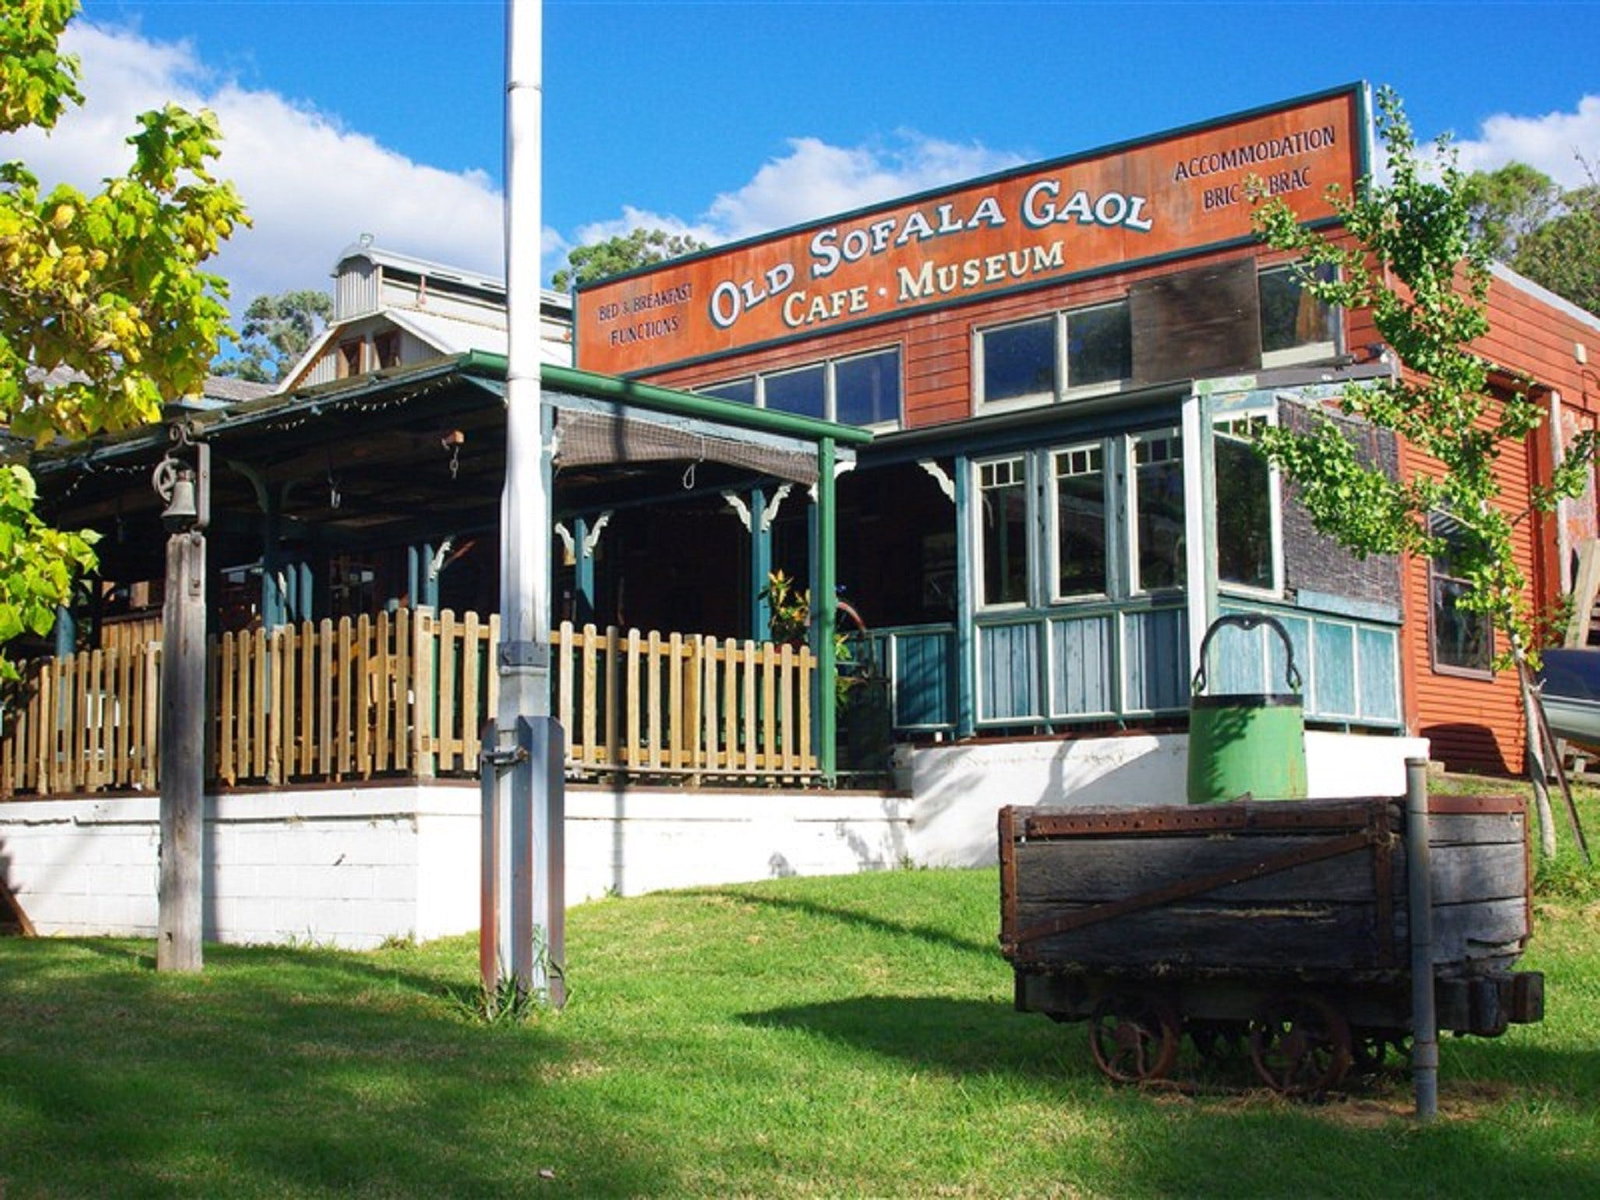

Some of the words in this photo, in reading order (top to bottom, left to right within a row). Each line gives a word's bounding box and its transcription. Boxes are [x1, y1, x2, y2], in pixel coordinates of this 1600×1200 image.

[1174, 125, 1336, 181] ACCOMMODATION
[1203, 184, 1240, 211] BRIC
[1268, 167, 1312, 195] BRAC
[709, 261, 795, 328] OLD
[810, 196, 1006, 278] SOFALA
[1023, 180, 1153, 232] GAOL
[598, 303, 619, 322] BED
[633, 283, 692, 313] BREAKFAST
[782, 284, 869, 328] CAFE
[897, 240, 1065, 301] MUSEUM
[611, 315, 679, 346] FUNCTIONS
